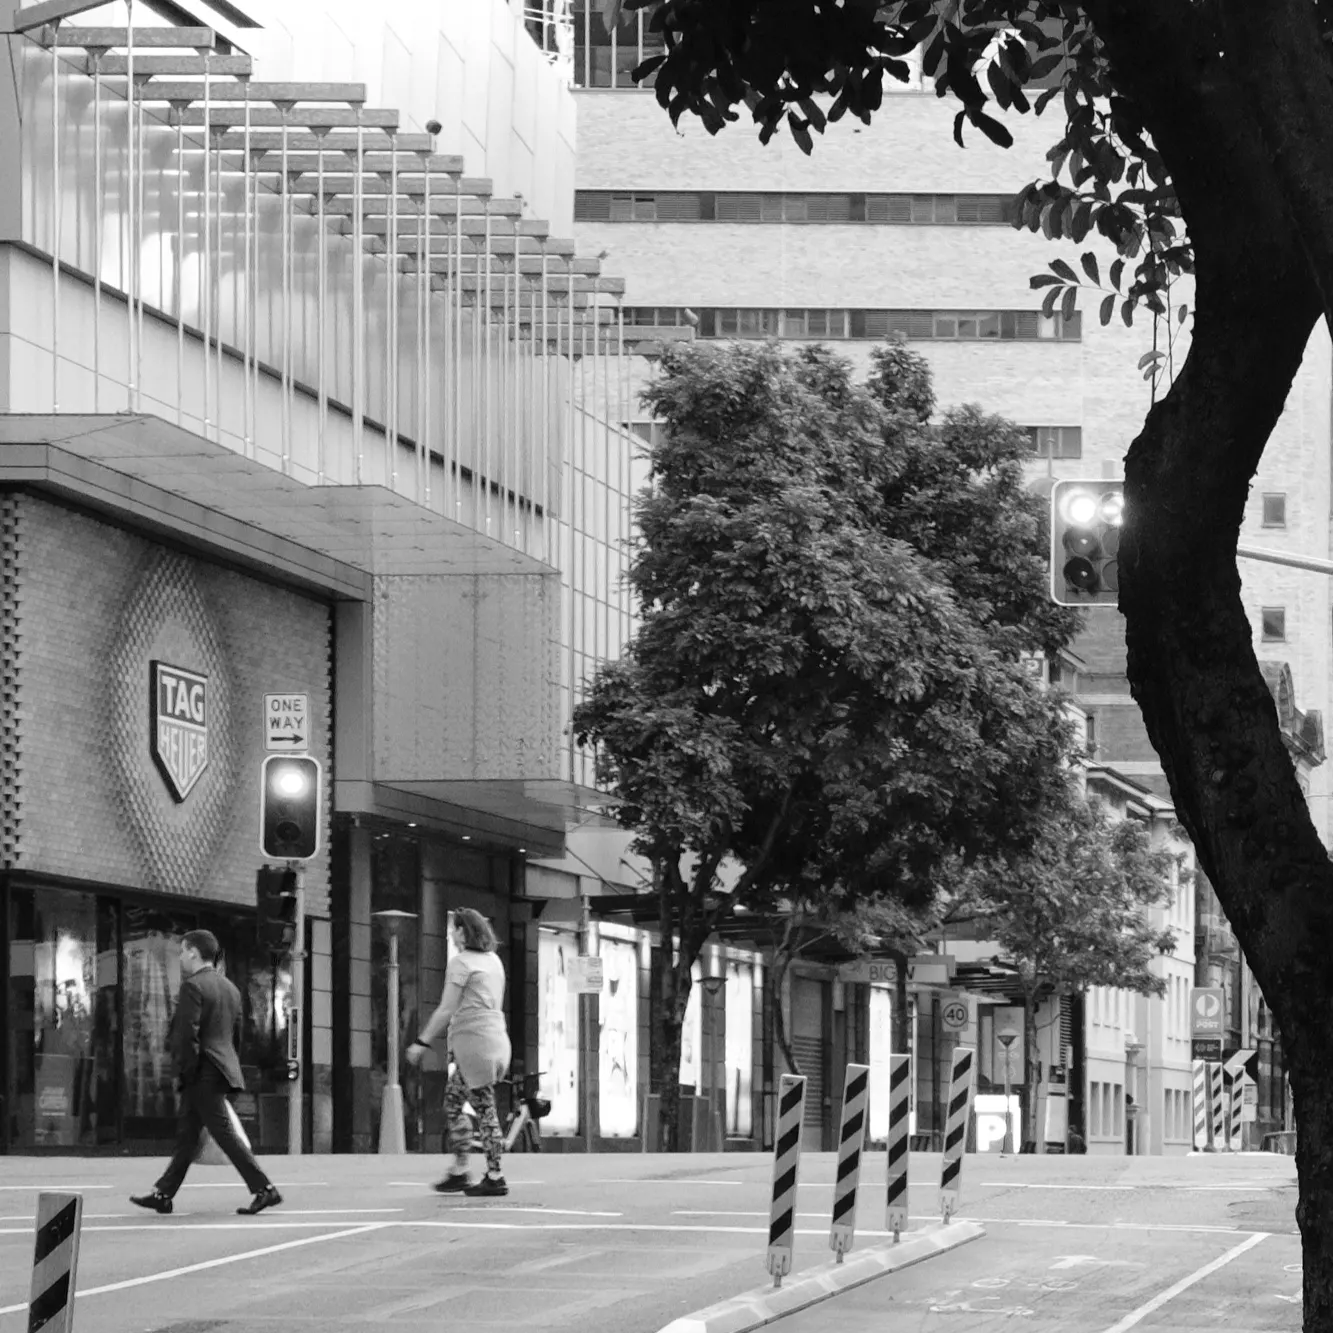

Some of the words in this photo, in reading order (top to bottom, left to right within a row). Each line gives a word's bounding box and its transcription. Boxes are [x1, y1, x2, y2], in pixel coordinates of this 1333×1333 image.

[161, 676, 204, 722] TAG
[270, 698, 303, 713] ONE
[269, 716, 304, 730] WAY
[159, 725, 205, 787] HEUER
[869, 965, 896, 981] BIG
[946, 1008, 965, 1021] 40
